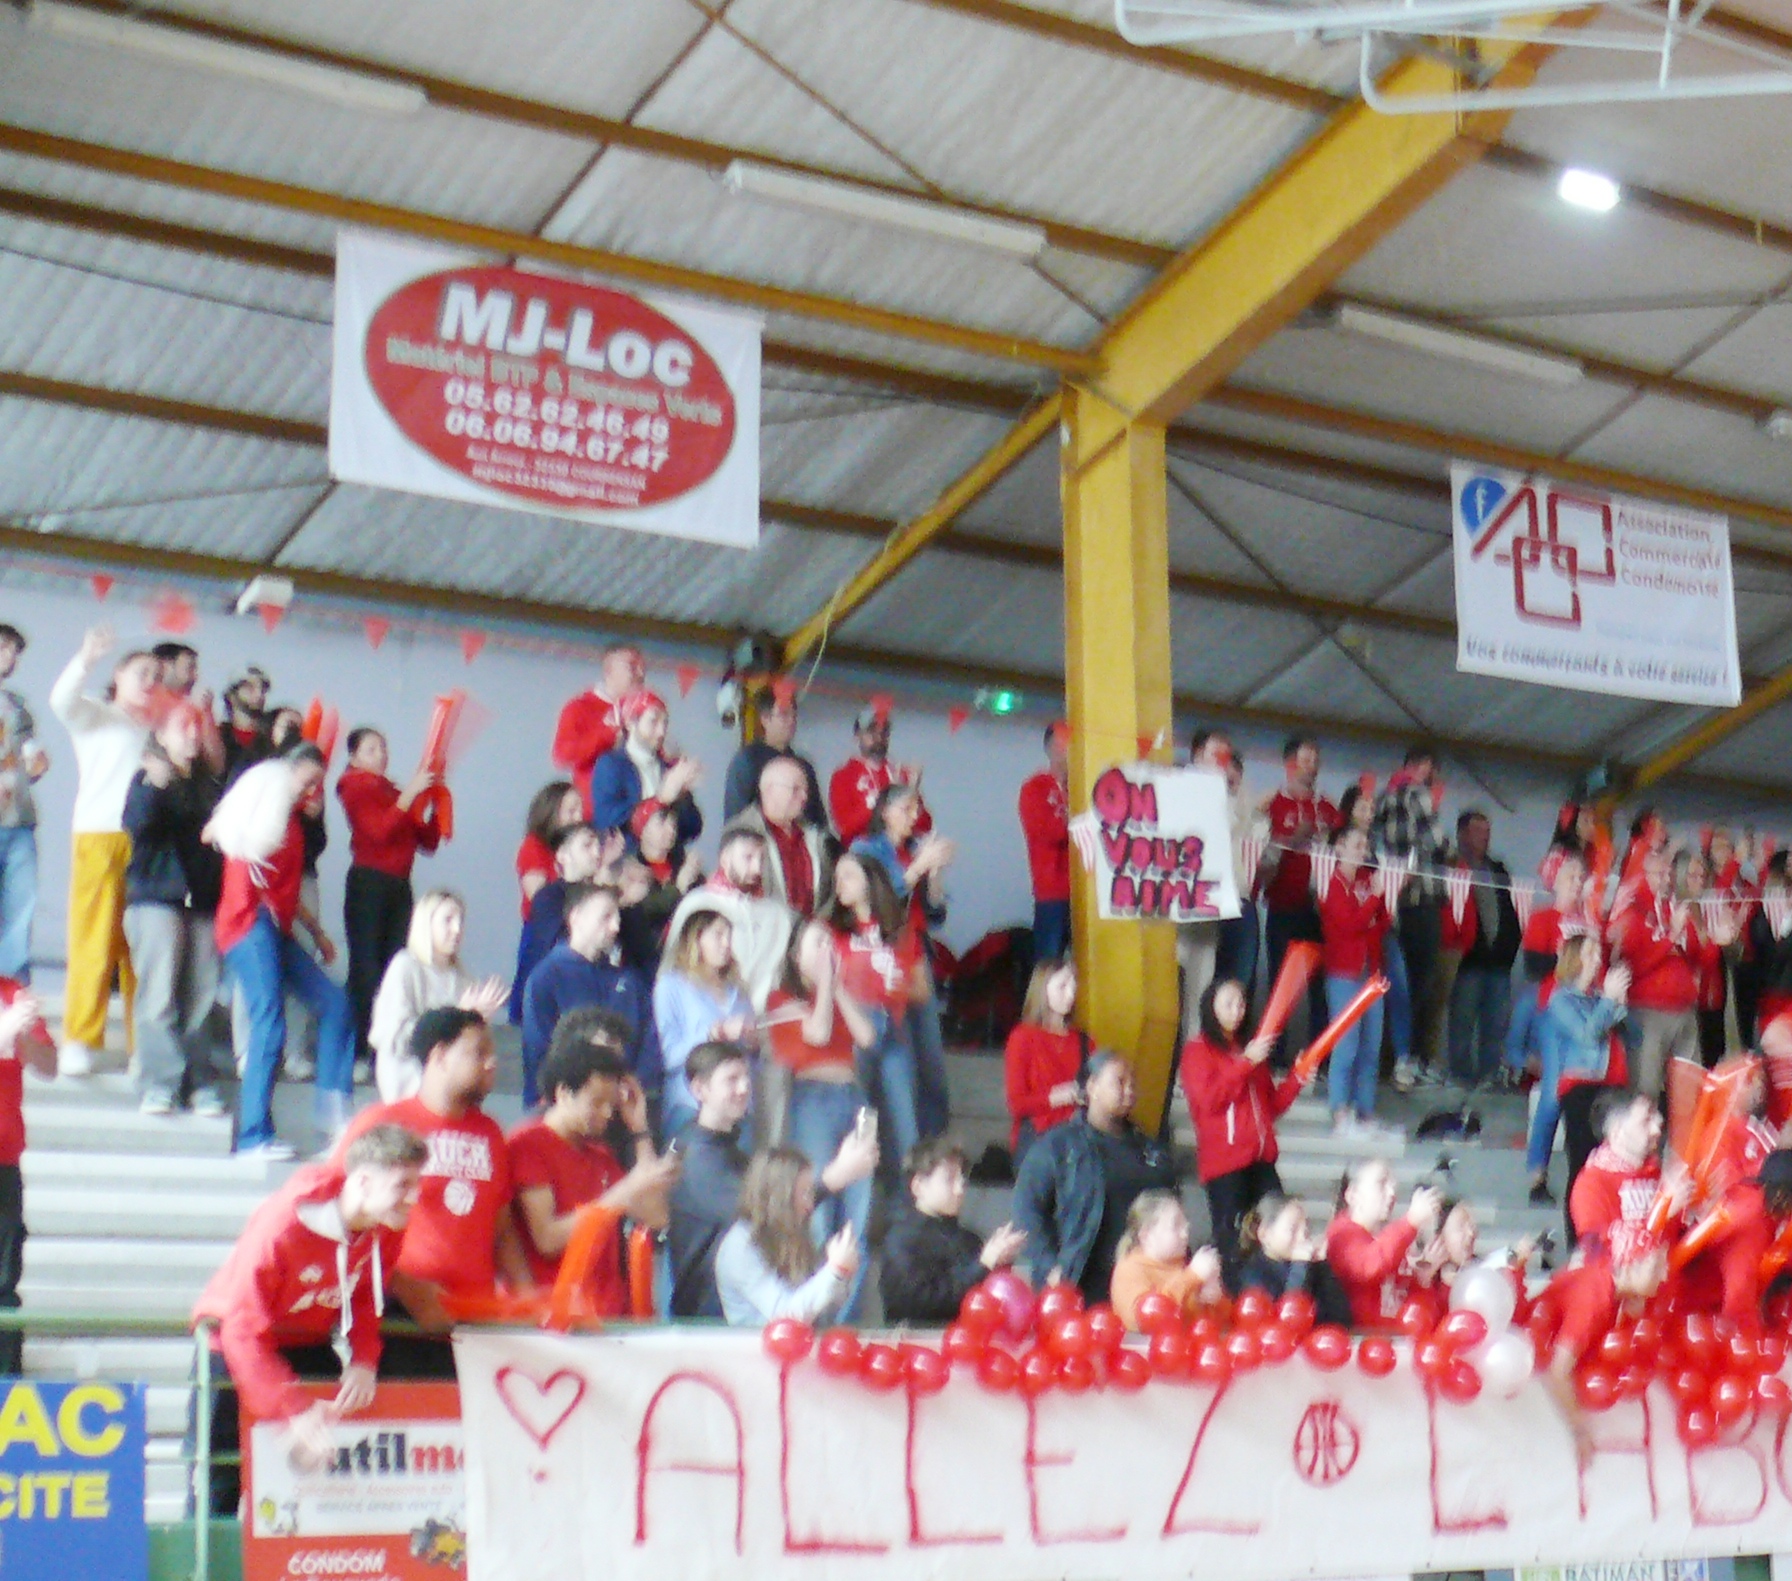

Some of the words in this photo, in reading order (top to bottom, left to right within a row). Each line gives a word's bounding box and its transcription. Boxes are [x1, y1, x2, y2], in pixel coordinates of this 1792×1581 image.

[1092, 767, 1159, 830] ON
[1101, 829, 1205, 879] VOUS
[1110, 874, 1221, 919] AIME
[631, 1364, 1262, 1556] ALLEZ
